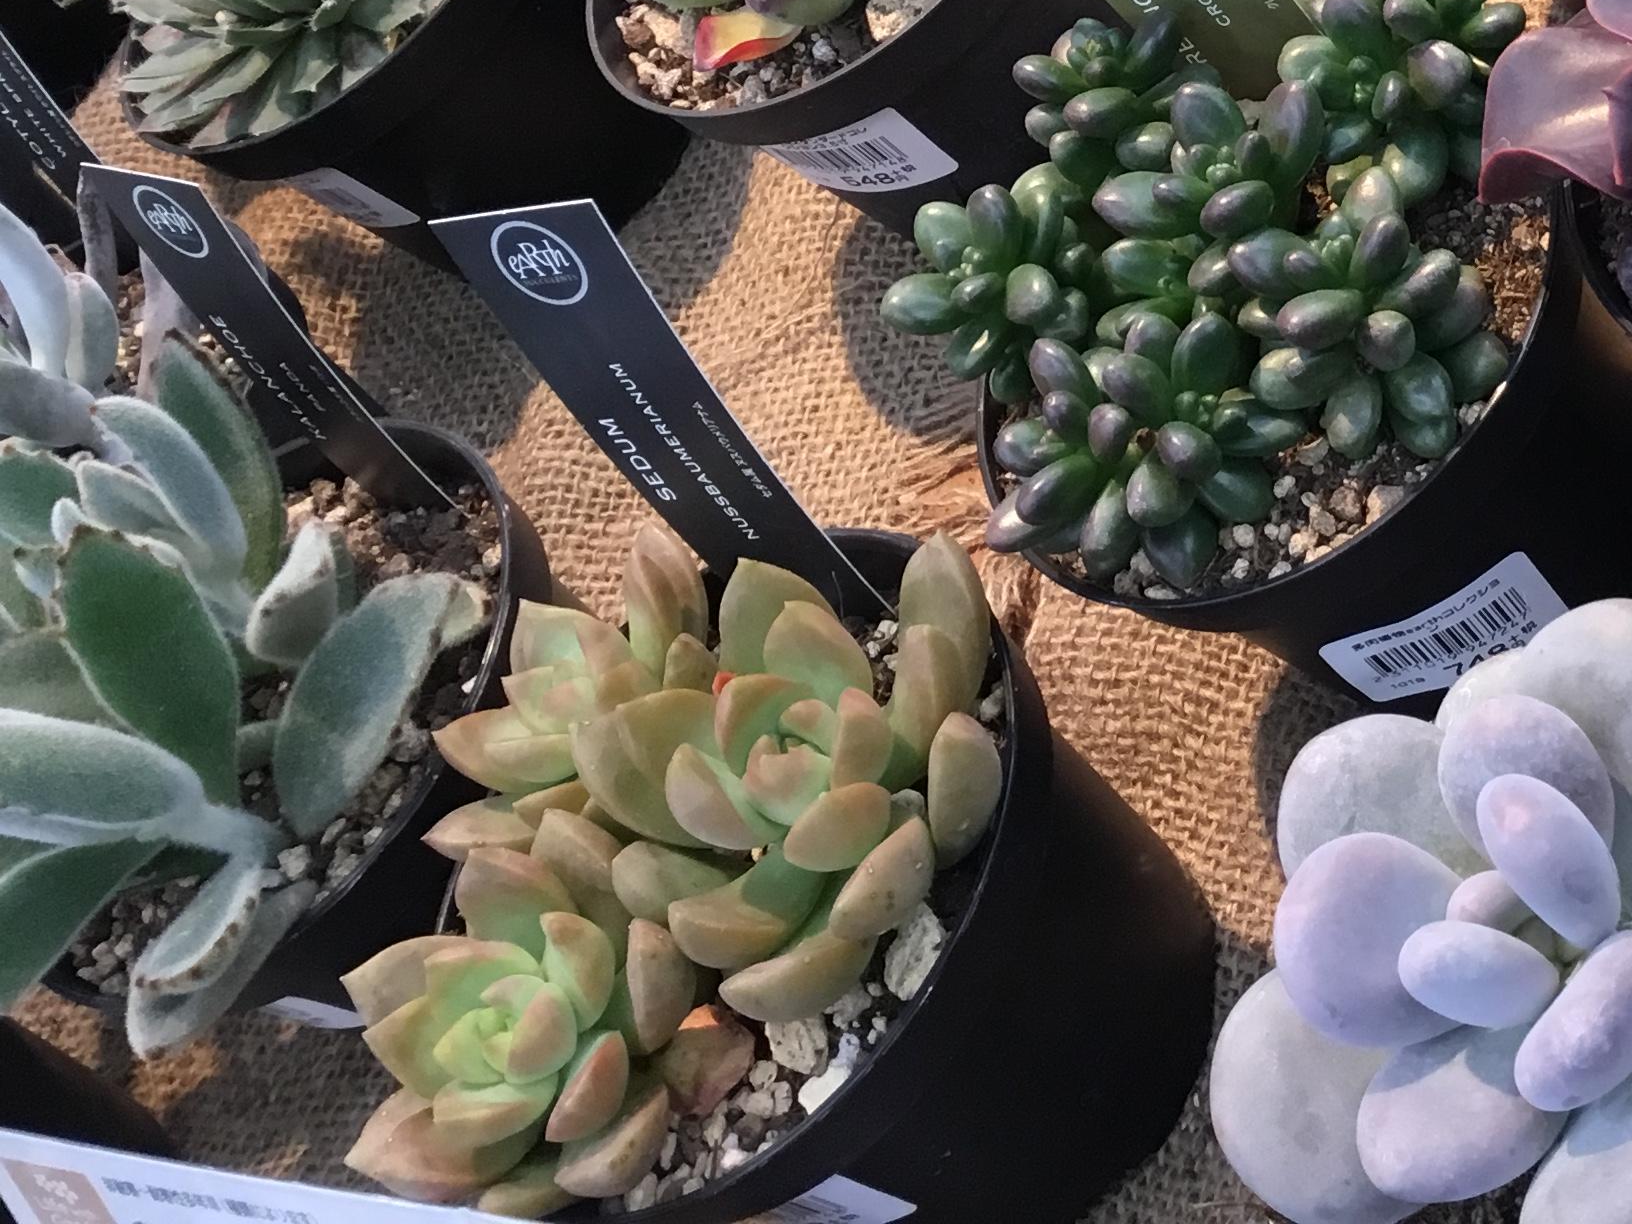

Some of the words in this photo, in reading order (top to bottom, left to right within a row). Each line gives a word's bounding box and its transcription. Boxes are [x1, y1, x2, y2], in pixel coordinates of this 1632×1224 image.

[839, 172, 896, 187] 548
[208, 314, 328, 440] KALANCHOE
[598, 417, 677, 502] SEDUM
[609, 363, 760, 540] NUSSBAUMERIANUM
